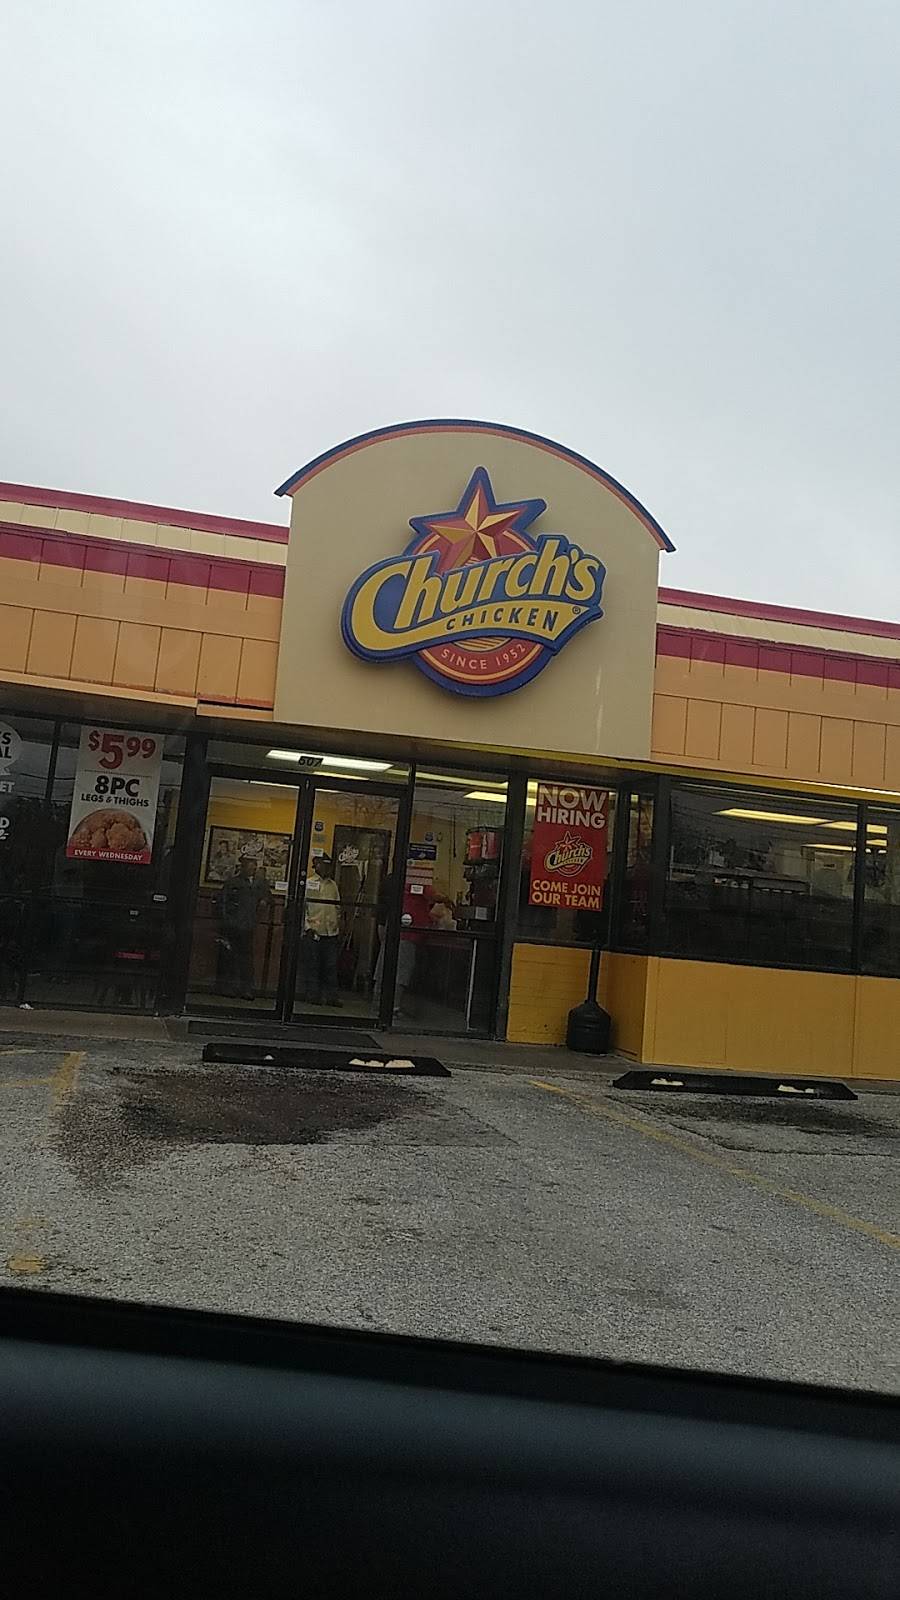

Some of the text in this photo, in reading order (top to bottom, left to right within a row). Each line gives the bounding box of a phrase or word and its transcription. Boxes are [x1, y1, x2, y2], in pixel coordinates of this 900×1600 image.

[351, 538, 600, 650] Church's
[445, 606, 559, 632] CHICKEN
[440, 643, 527, 670] SINCE 1952
[94, 775, 140, 798] 8PC
[538, 785, 607, 811] NOW
[80, 793, 149, 807] LEGS & THIGHS
[537, 806, 606, 829] HIRING
[74, 849, 143, 861] EVERY WEDNESDAY
[532, 880, 601, 896] COME JOIN
[531, 891, 599, 909] OUR TEAM
